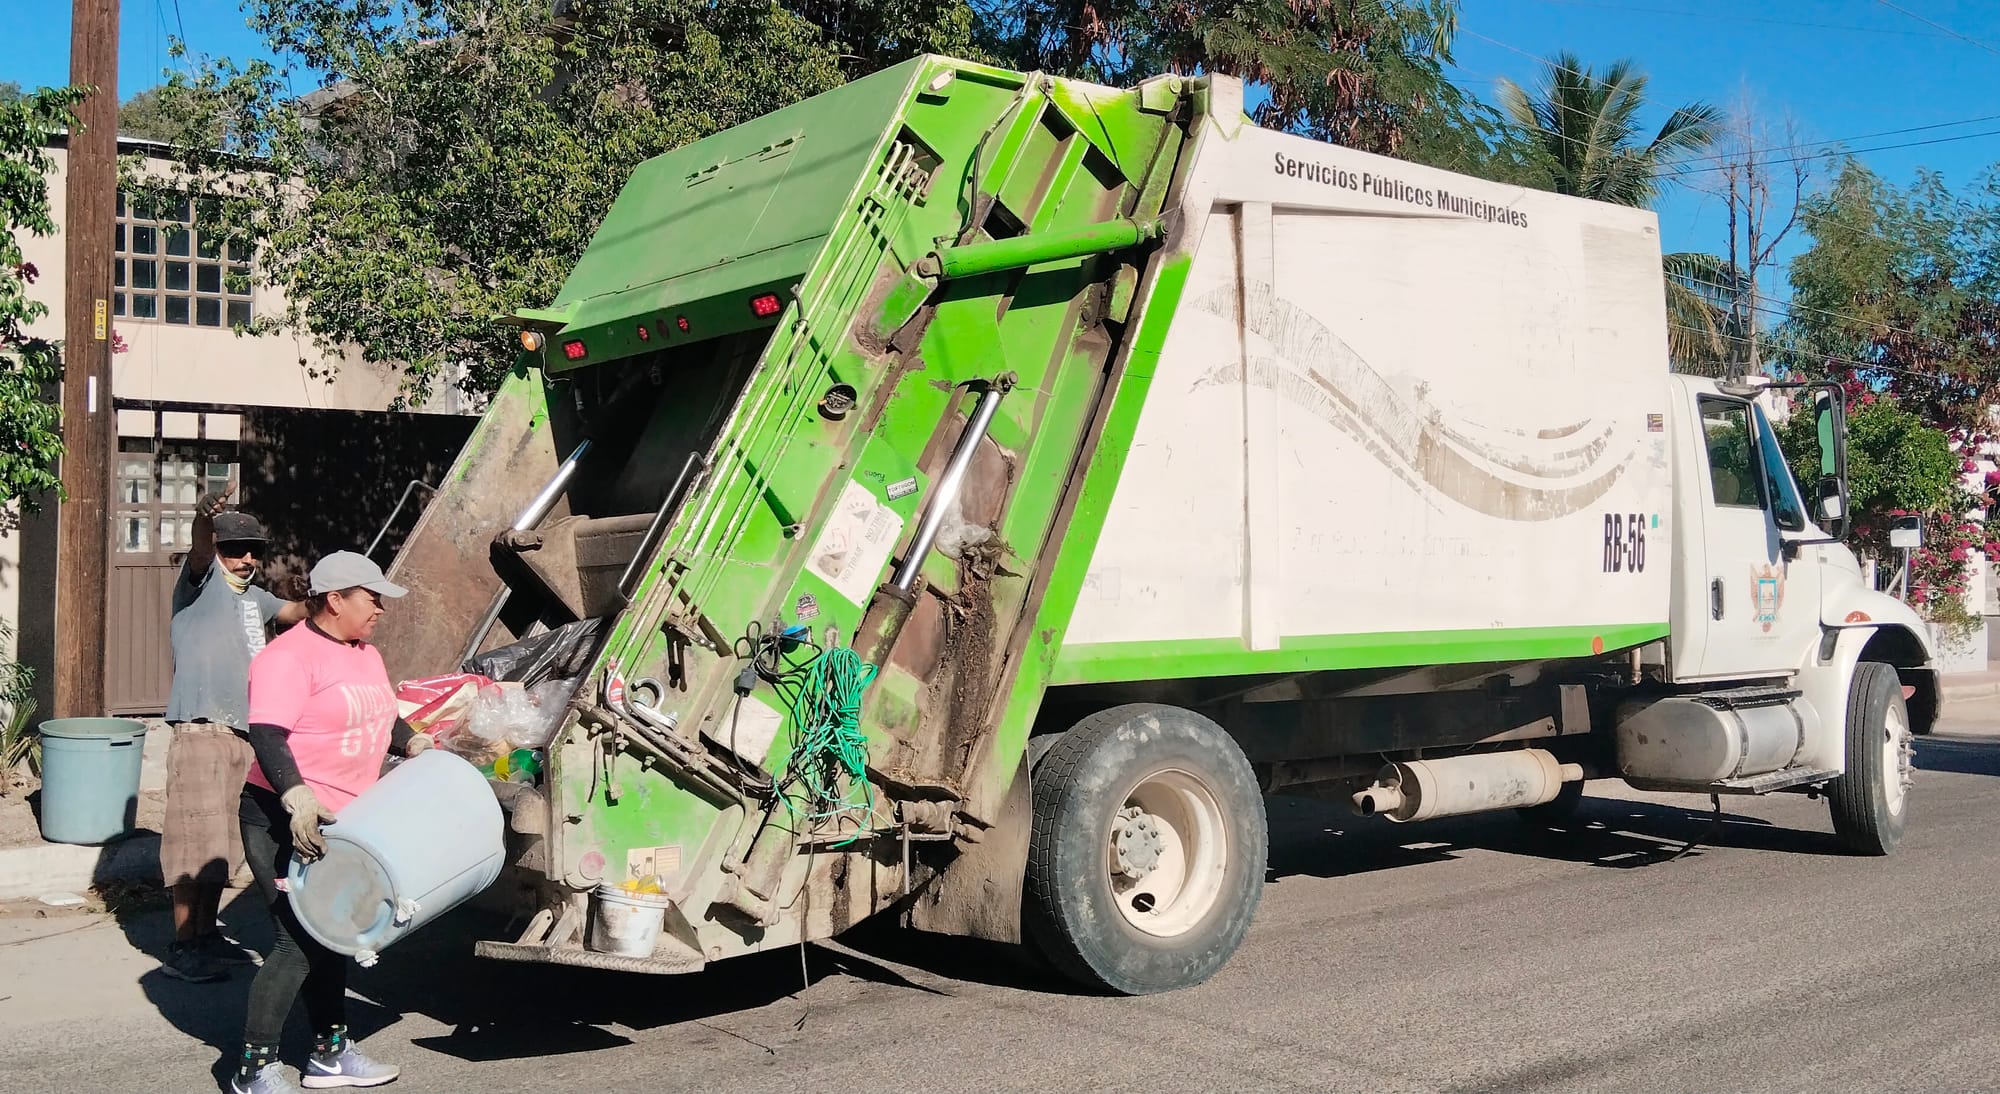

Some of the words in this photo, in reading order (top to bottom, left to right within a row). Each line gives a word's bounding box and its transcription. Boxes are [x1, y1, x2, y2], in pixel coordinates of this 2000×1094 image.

[1275, 152, 1358, 190] Servicios
[1363, 172, 1433, 208] Públicos
[1603, 513, 1645, 573] RB-56
